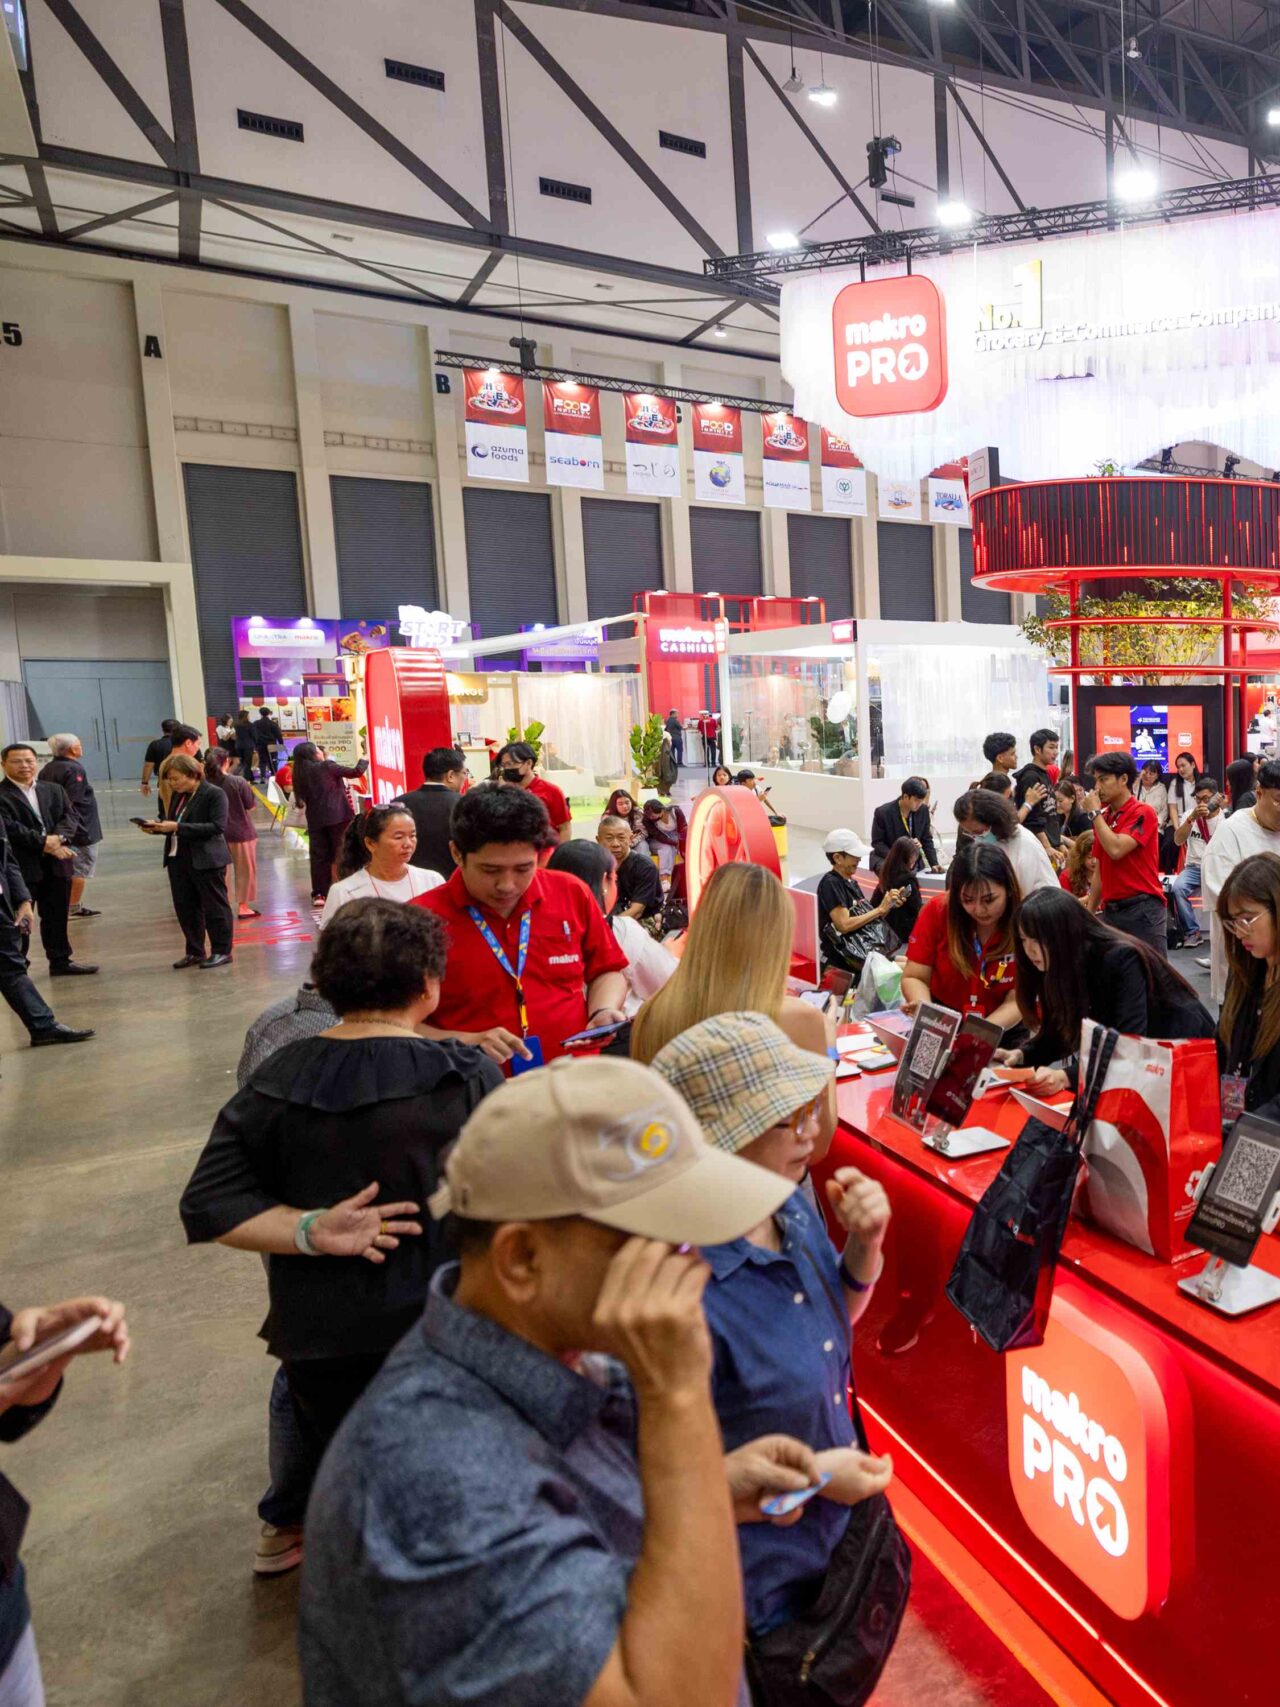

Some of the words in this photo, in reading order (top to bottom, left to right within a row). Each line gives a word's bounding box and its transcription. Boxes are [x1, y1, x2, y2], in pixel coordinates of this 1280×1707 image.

[0, 322, 23, 346] 5
[846, 312, 927, 345] makro
[144, 335, 162, 359] A
[975, 329, 1047, 352] Grocery
[847, 343, 928, 387] PRO
[436, 373, 451, 394] B
[553, 398, 591, 412] FOOD
[491, 445, 524, 455] azuma
[491, 452, 519, 463] foods
[550, 455, 600, 469] seaborn
[402, 621, 461, 634] START
[659, 627, 715, 644] makro
[660, 641, 715, 653] CASHIER
[548, 953, 579, 965] makro
[1021, 1365, 1127, 1482] makro
[1023, 1413, 1129, 1557] PRO
